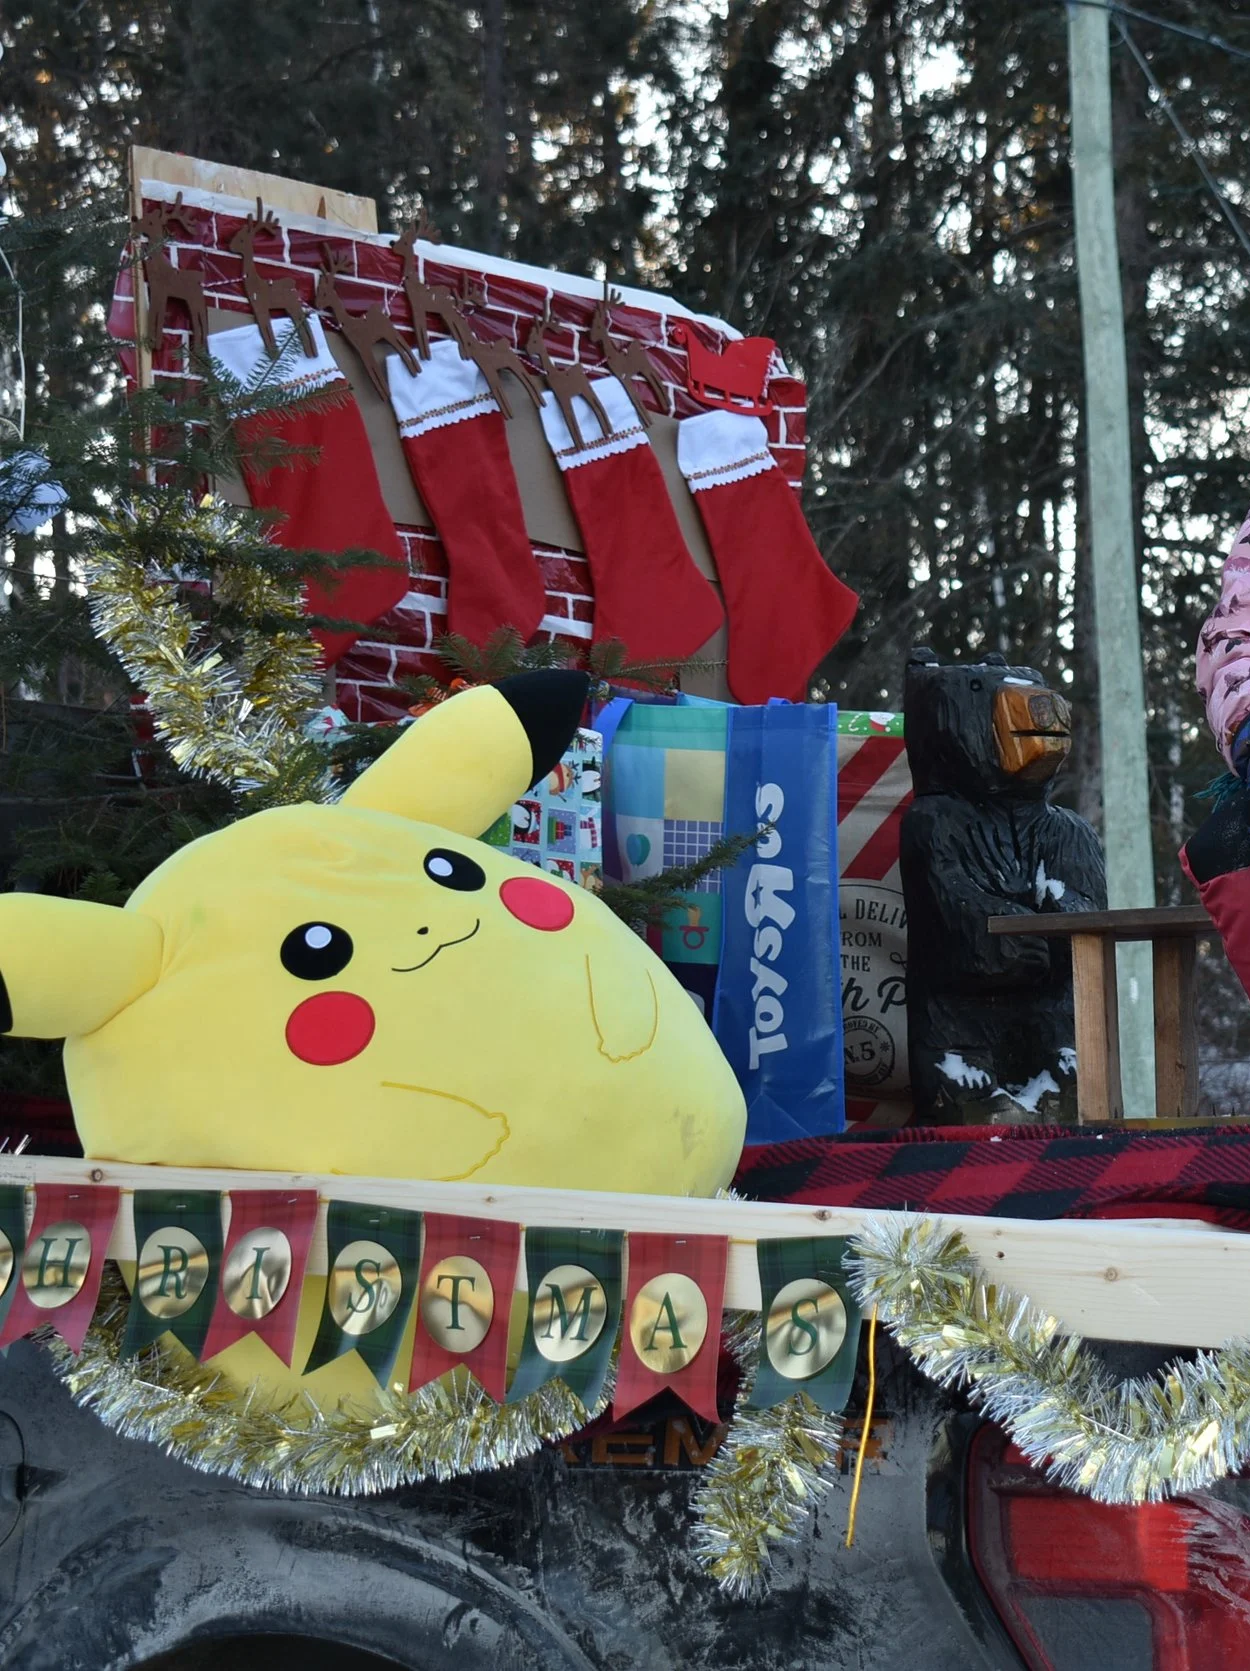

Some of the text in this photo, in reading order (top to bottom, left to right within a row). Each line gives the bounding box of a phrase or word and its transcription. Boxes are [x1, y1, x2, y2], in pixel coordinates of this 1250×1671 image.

[855, 898, 908, 928] DELIV
[839, 931, 882, 948] ROM
[839, 953, 871, 973] THE
[33, 1236, 820, 1357] HRISTMAS
